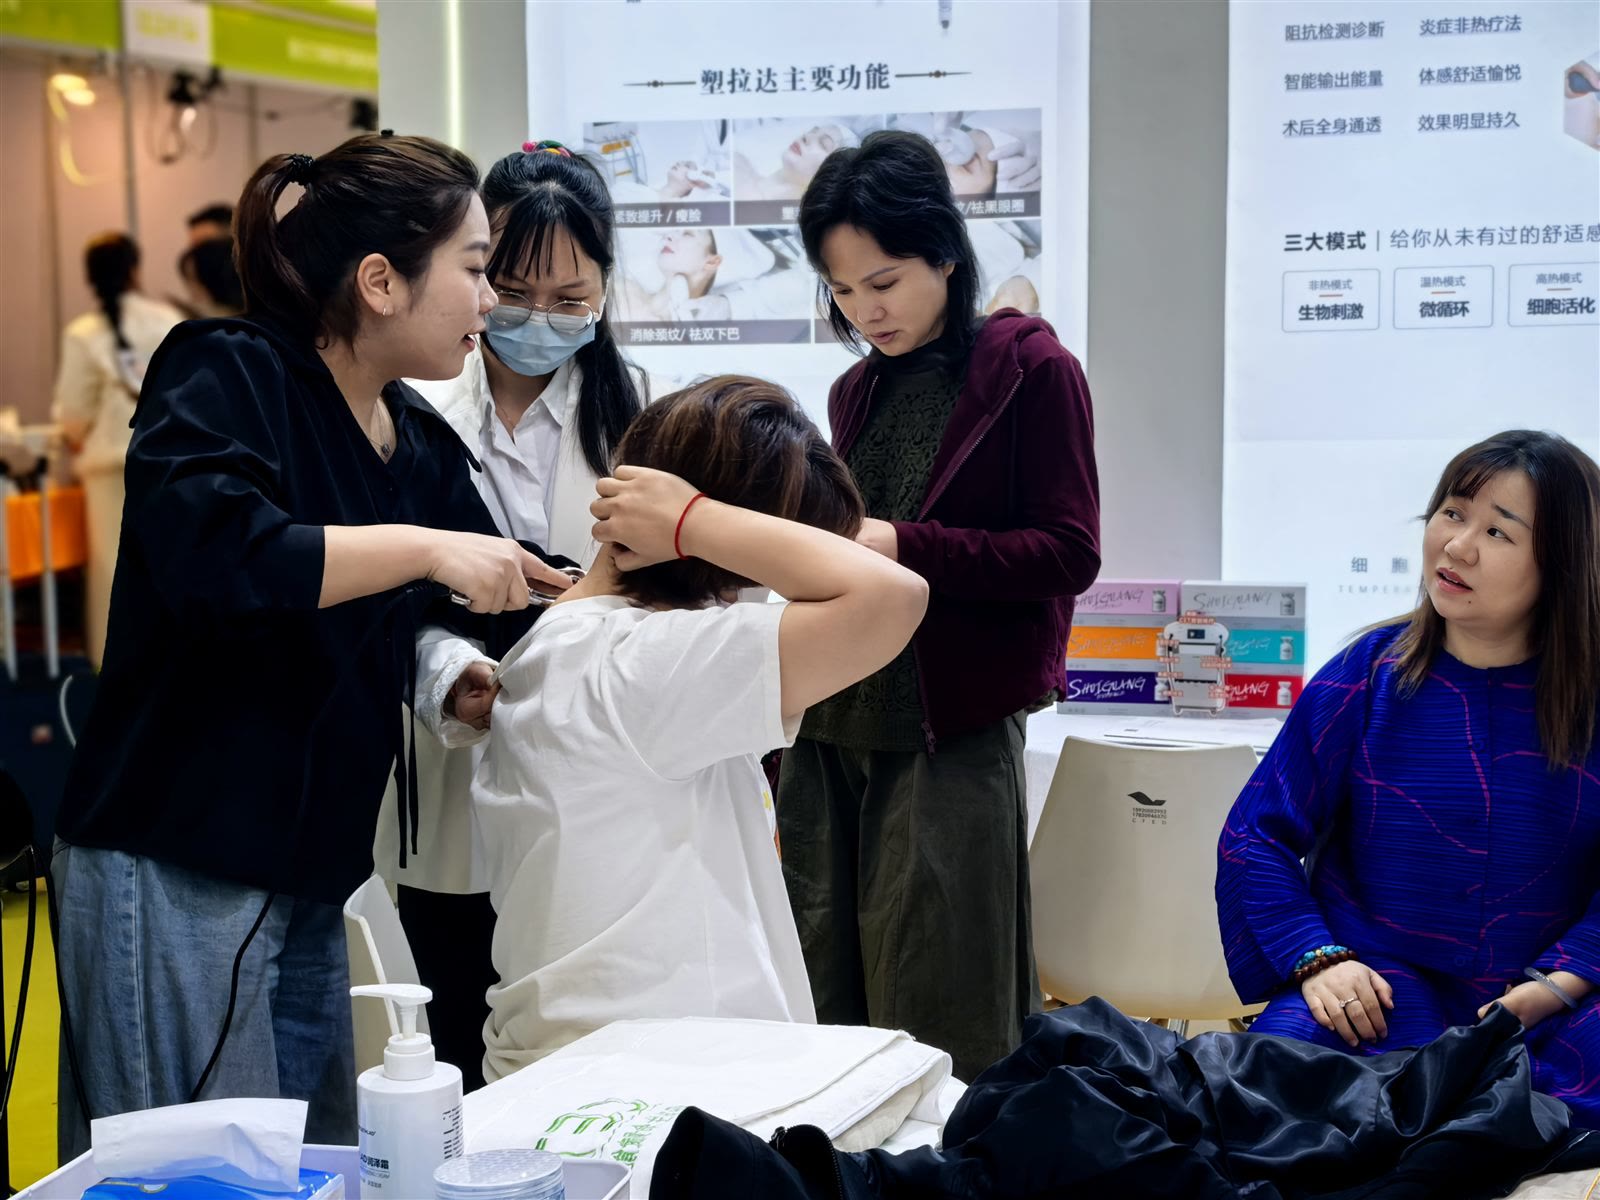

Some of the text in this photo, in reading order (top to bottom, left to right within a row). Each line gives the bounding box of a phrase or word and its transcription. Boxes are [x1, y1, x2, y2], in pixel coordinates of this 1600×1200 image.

[1285, 21, 1385, 42] 阻抗检测诊断
[1419, 15, 1522, 36] 炎症非热疗法
[700, 62, 892, 96] 塑拉达主要功能
[1284, 69, 1383, 91] 智能输出能量
[1418, 64, 1522, 85] 体感舒适愉悦
[1282, 115, 1382, 137] 术后全身通透
[1417, 111, 1521, 132] 效果明显持久
[1283, 222, 1600, 252] 三大模式 给你从未有过的舒适感
[1308, 278, 1353, 291] 非热模式
[1420, 275, 1466, 288] 温热模式
[1535, 272, 1583, 285] 高热模式
[1298, 303, 1364, 321] 生物刺激
[1419, 300, 1470, 319] 微循环
[1527, 296, 1596, 316] 细胞活化
